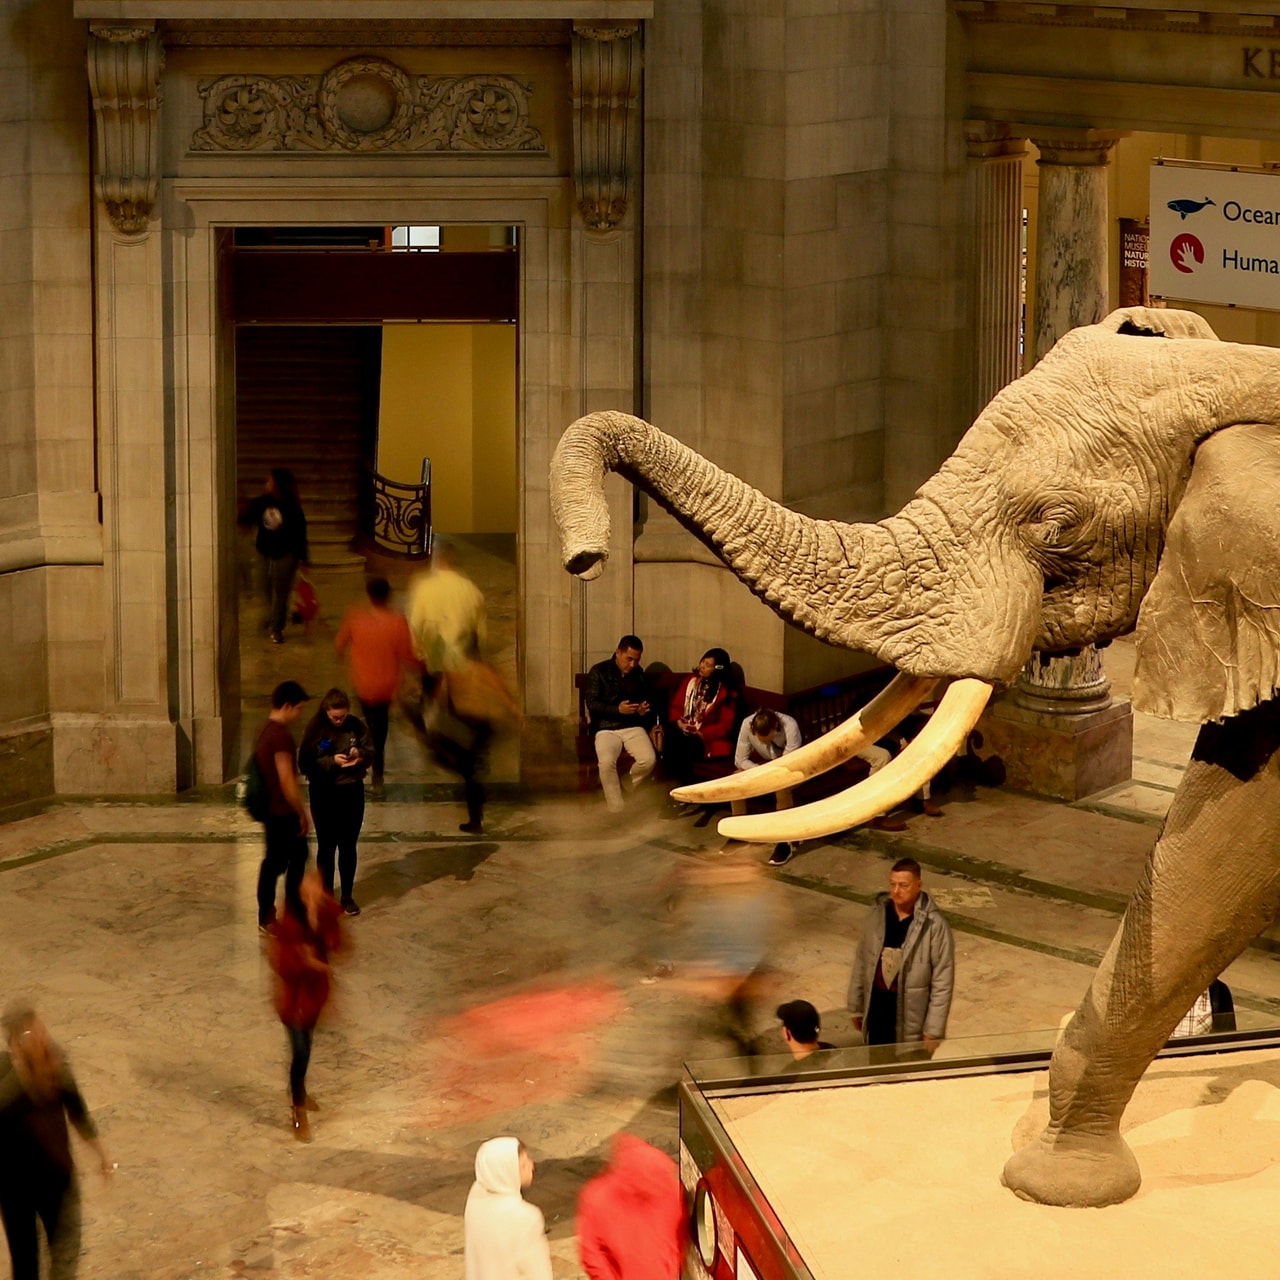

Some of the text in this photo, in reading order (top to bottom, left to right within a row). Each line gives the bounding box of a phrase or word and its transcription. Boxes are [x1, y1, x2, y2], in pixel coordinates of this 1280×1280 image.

[1124, 233, 1149, 242] NATIO
[1124, 242, 1149, 251] MUSEU
[1124, 250, 1149, 260] NATUR
[1124, 259, 1149, 268] HISTO
